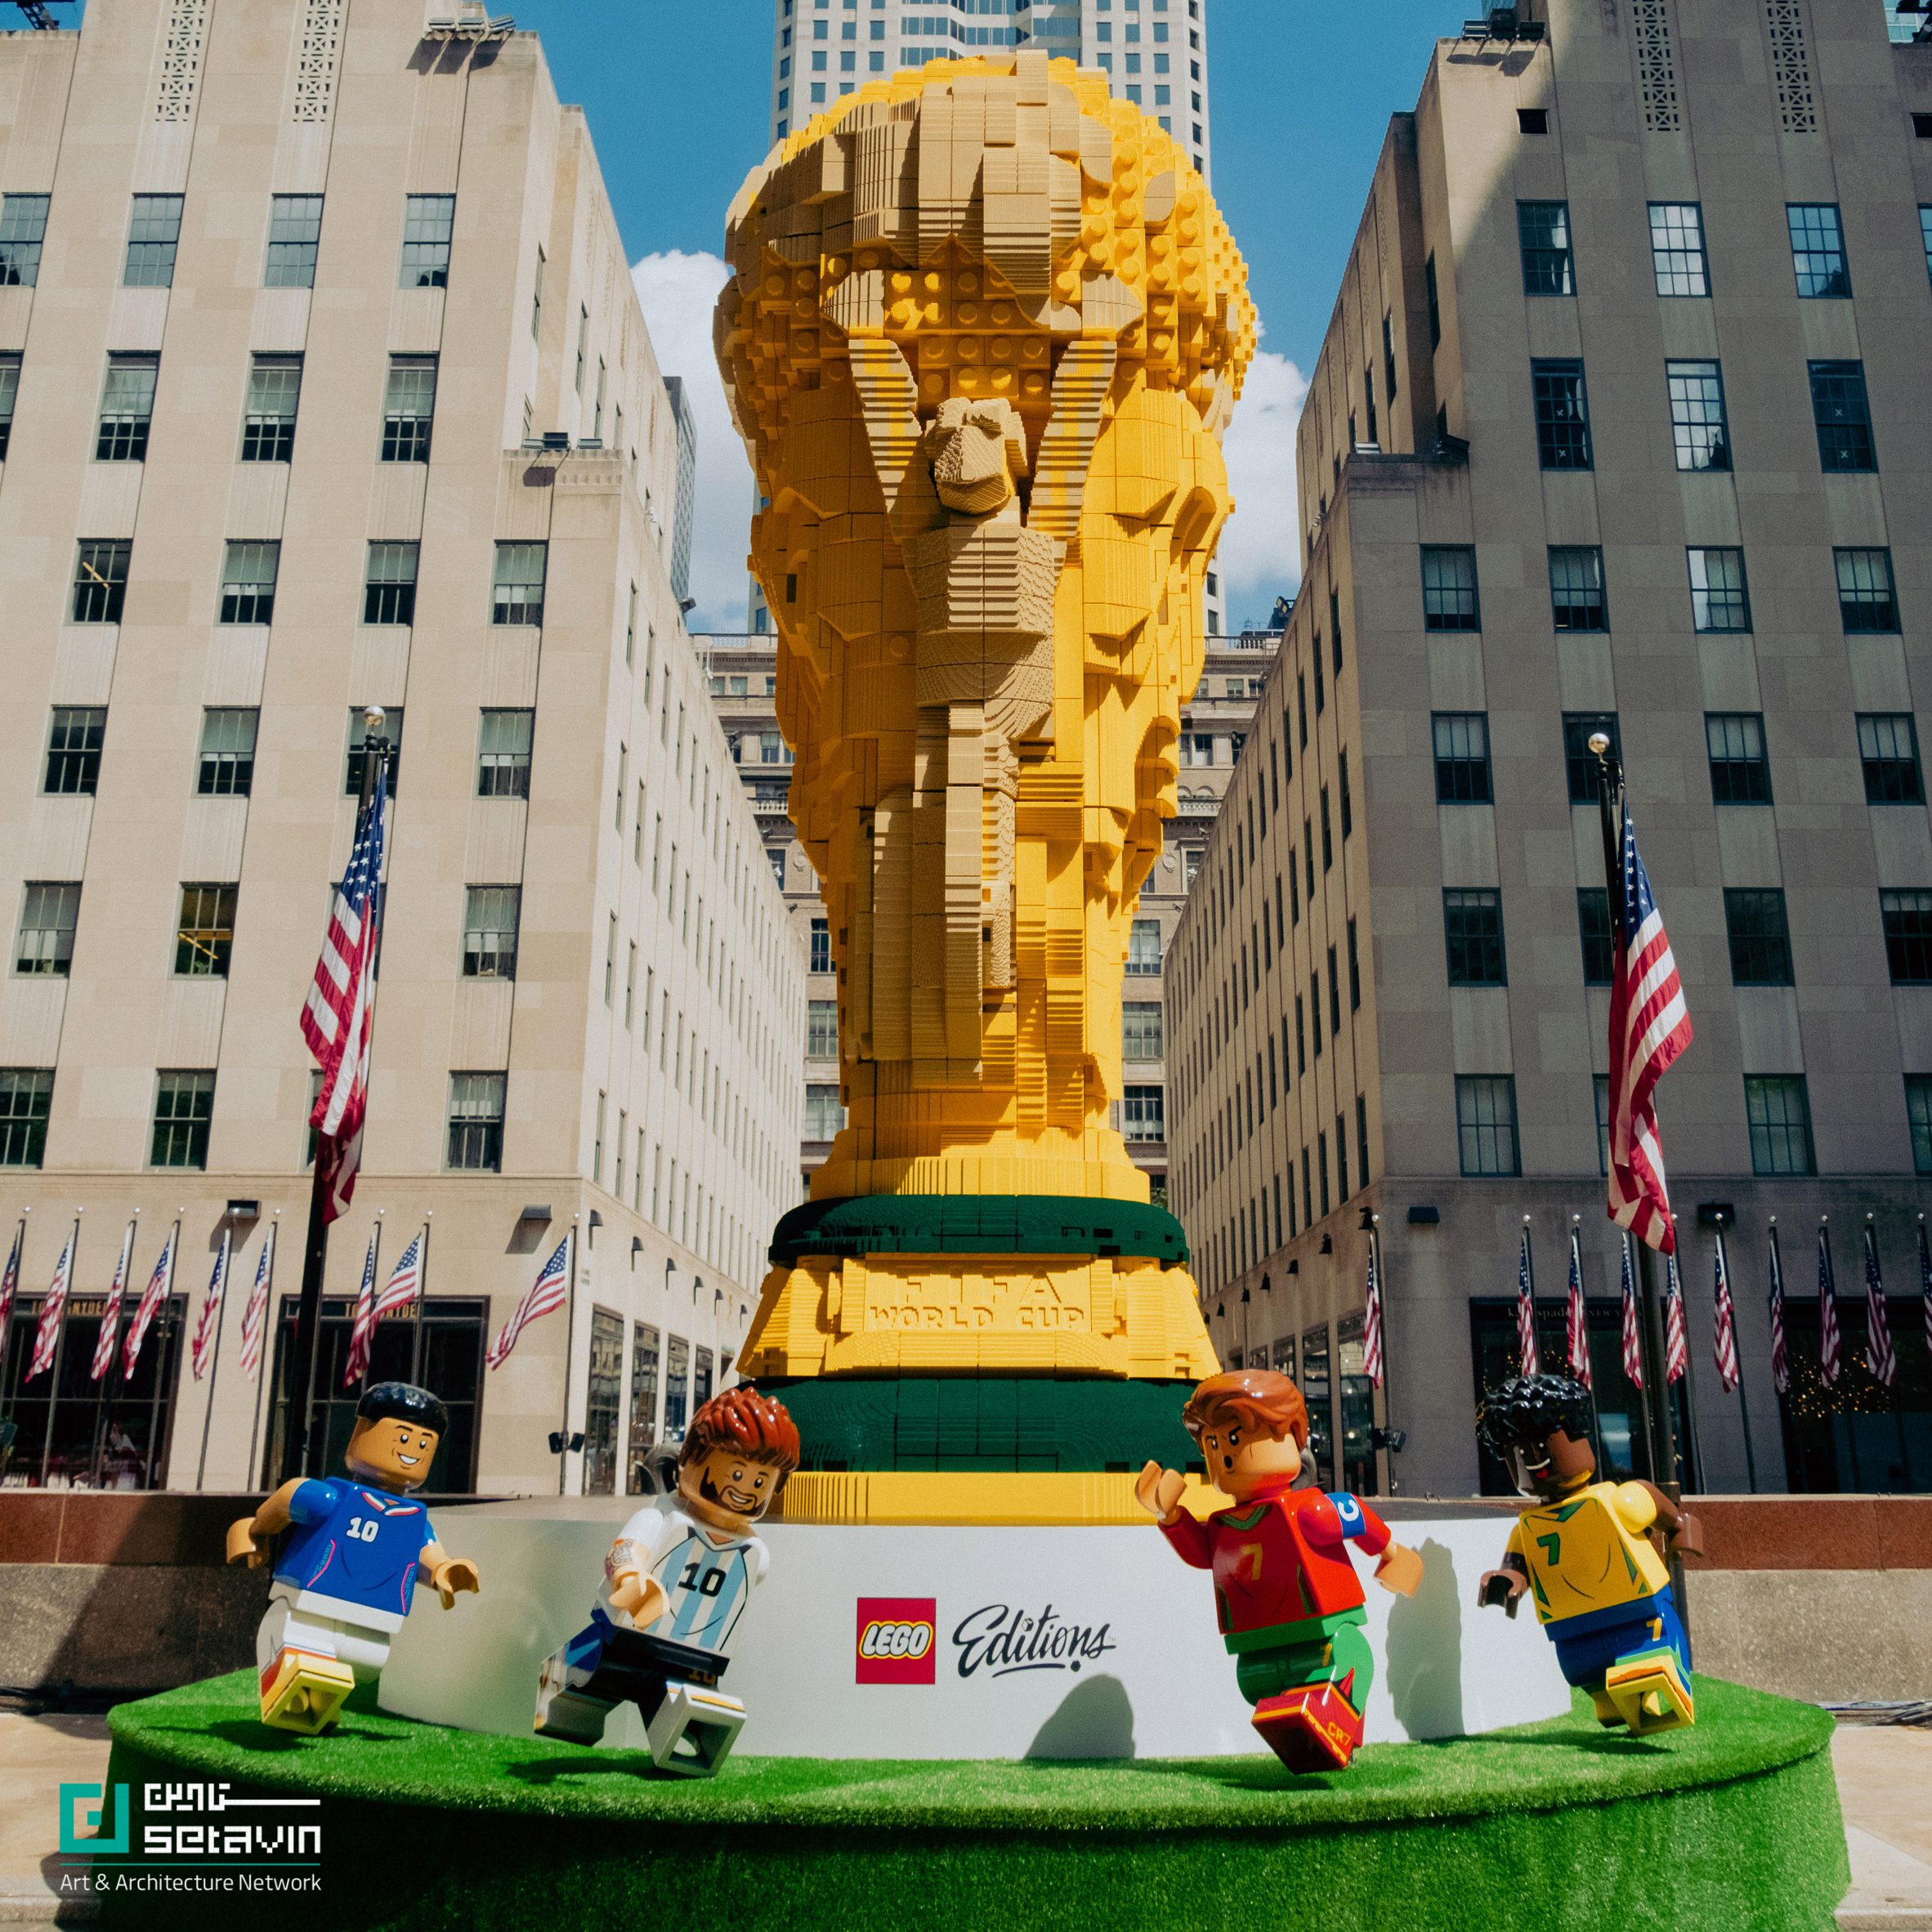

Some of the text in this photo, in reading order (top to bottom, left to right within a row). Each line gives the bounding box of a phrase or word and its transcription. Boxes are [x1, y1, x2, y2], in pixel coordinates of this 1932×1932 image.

[895, 1266, 1062, 1304] FIFA
[870, 1306, 1085, 1329] WORLD CUP
[1338, 1499, 1359, 1521] C
[347, 1517, 379, 1542] 10
[1240, 1542, 1263, 1581] 7
[1536, 1532, 1560, 1566] 7
[678, 1563, 727, 1597] 10
[861, 1603, 1116, 1678] LEGO Editions
[1646, 1617, 1663, 1641] 7
[1320, 1643, 1332, 1666] 7
[1328, 1721, 1351, 1746] CR7
